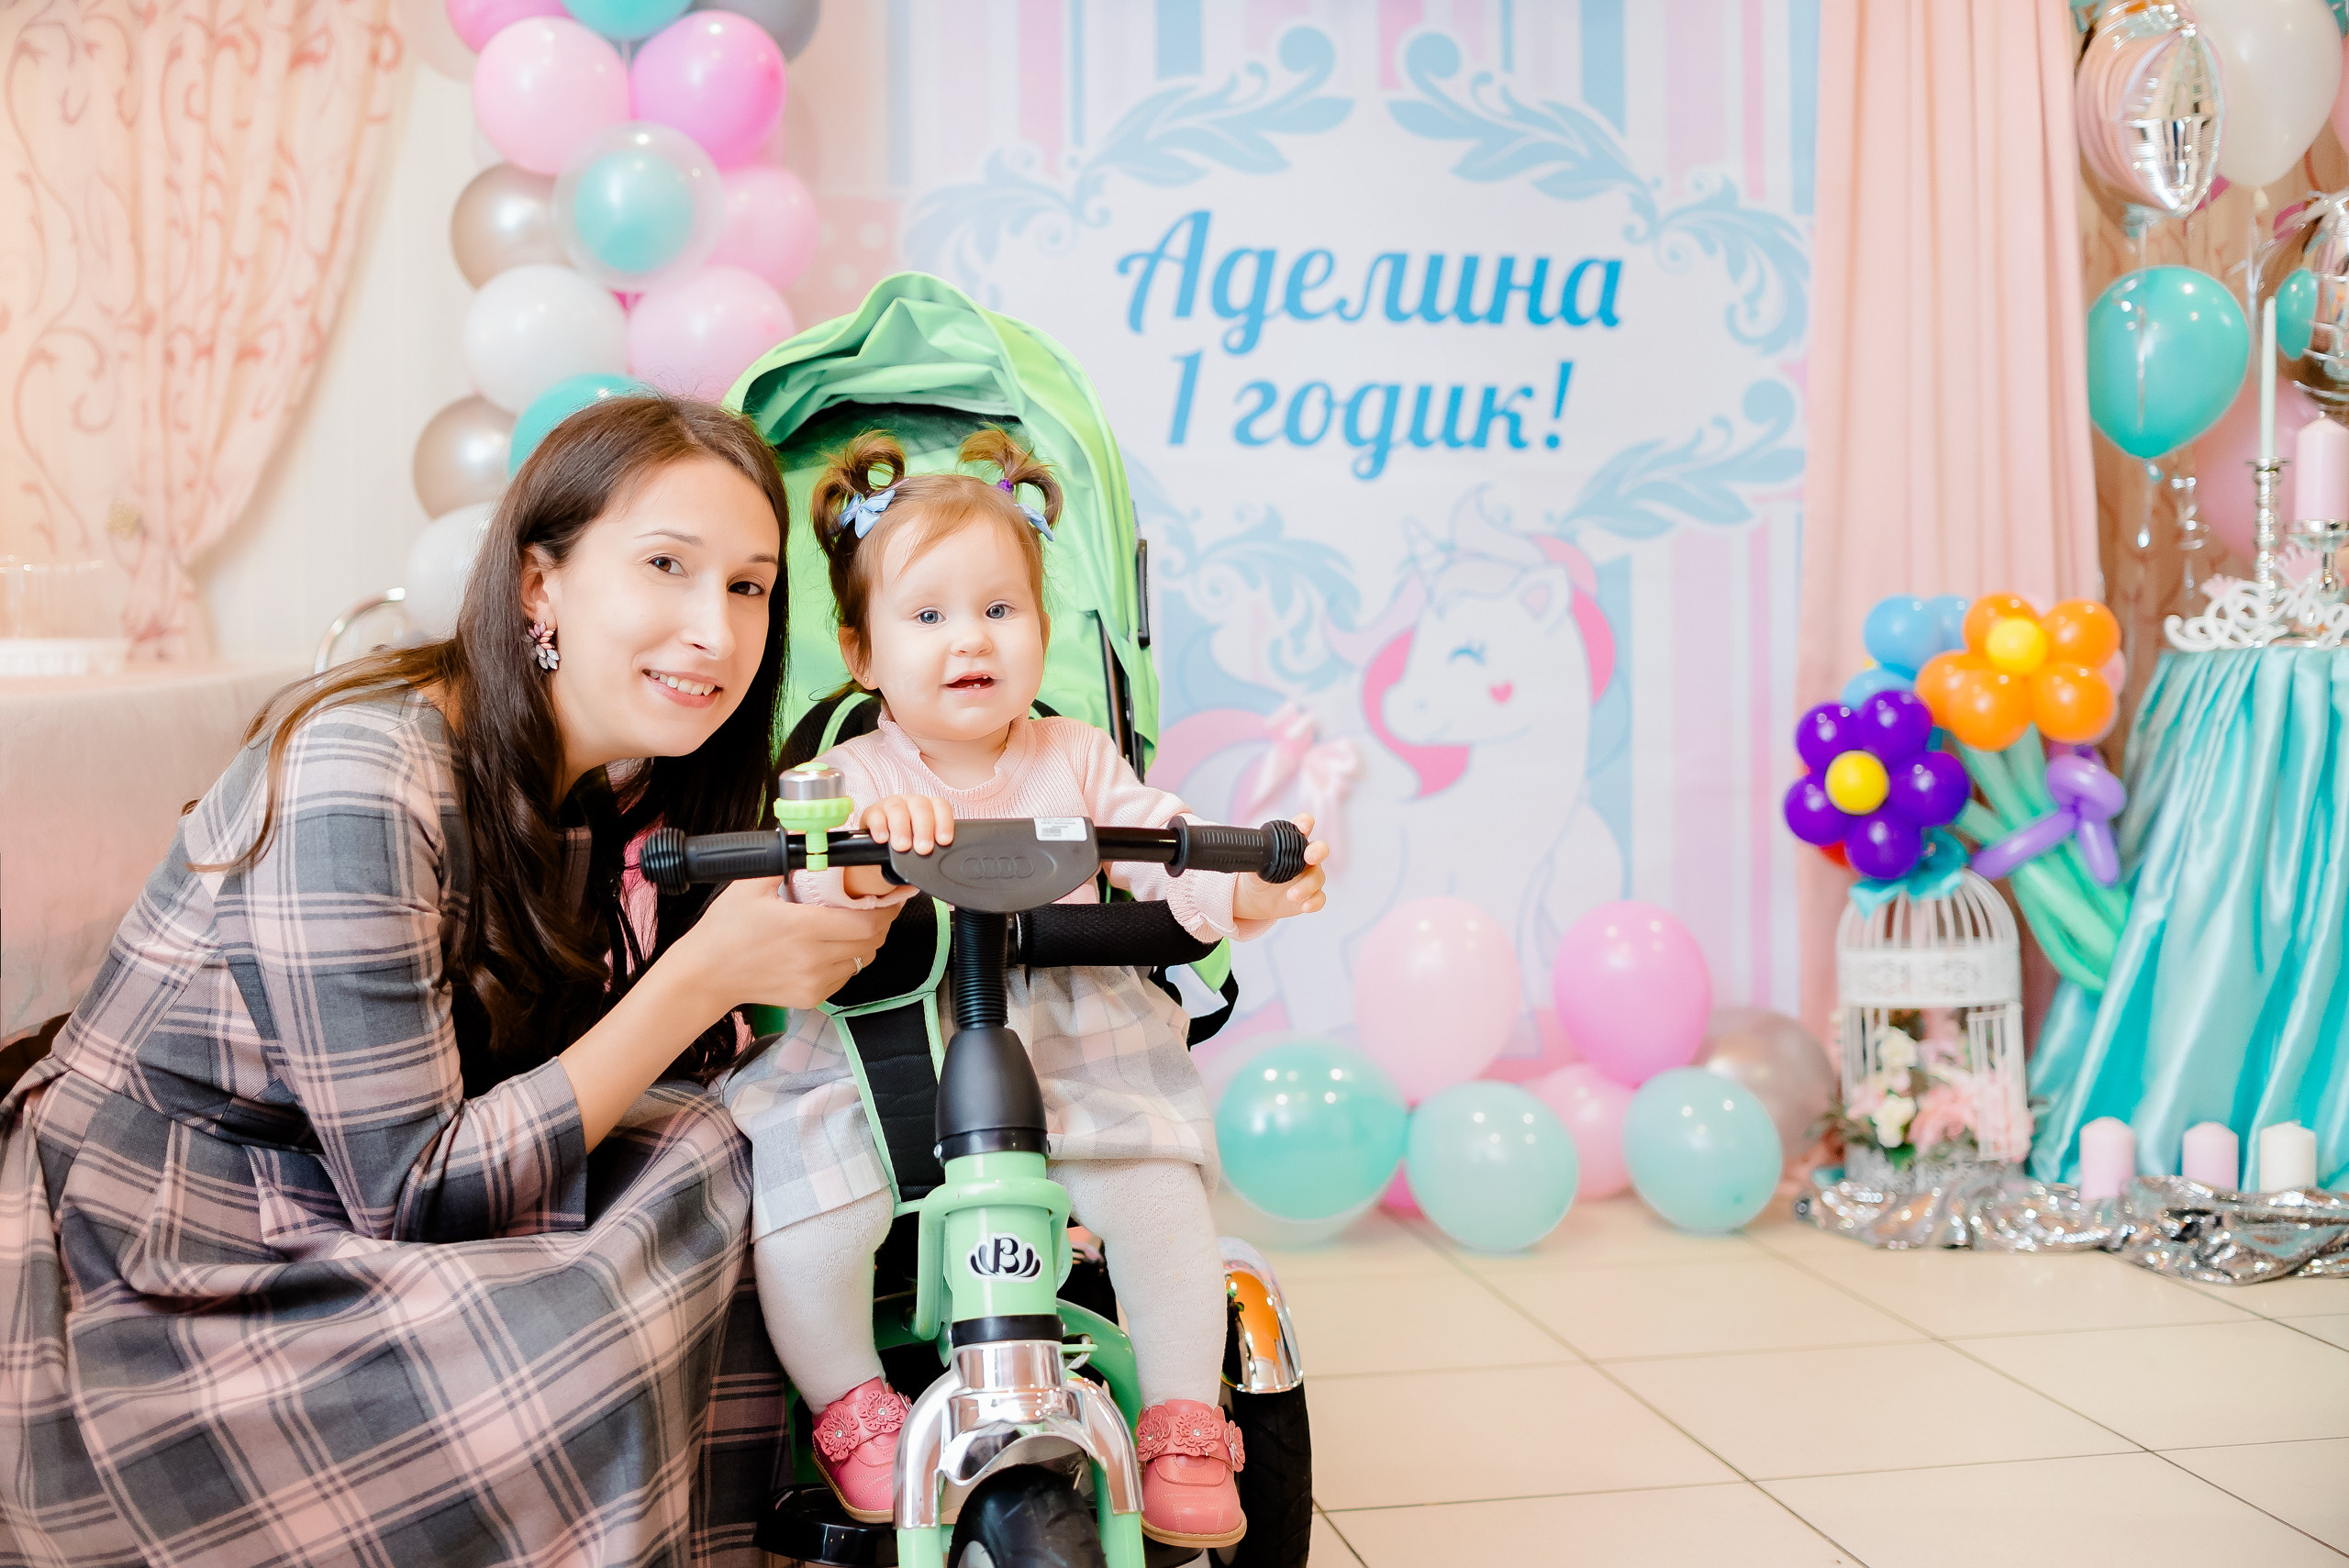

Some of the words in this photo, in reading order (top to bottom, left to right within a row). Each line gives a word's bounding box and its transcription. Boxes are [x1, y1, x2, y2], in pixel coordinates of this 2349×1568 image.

[1116, 209, 1624, 357] Аделина
[1168, 350, 1205, 446] 1
[1232, 359, 1576, 482] годик!
